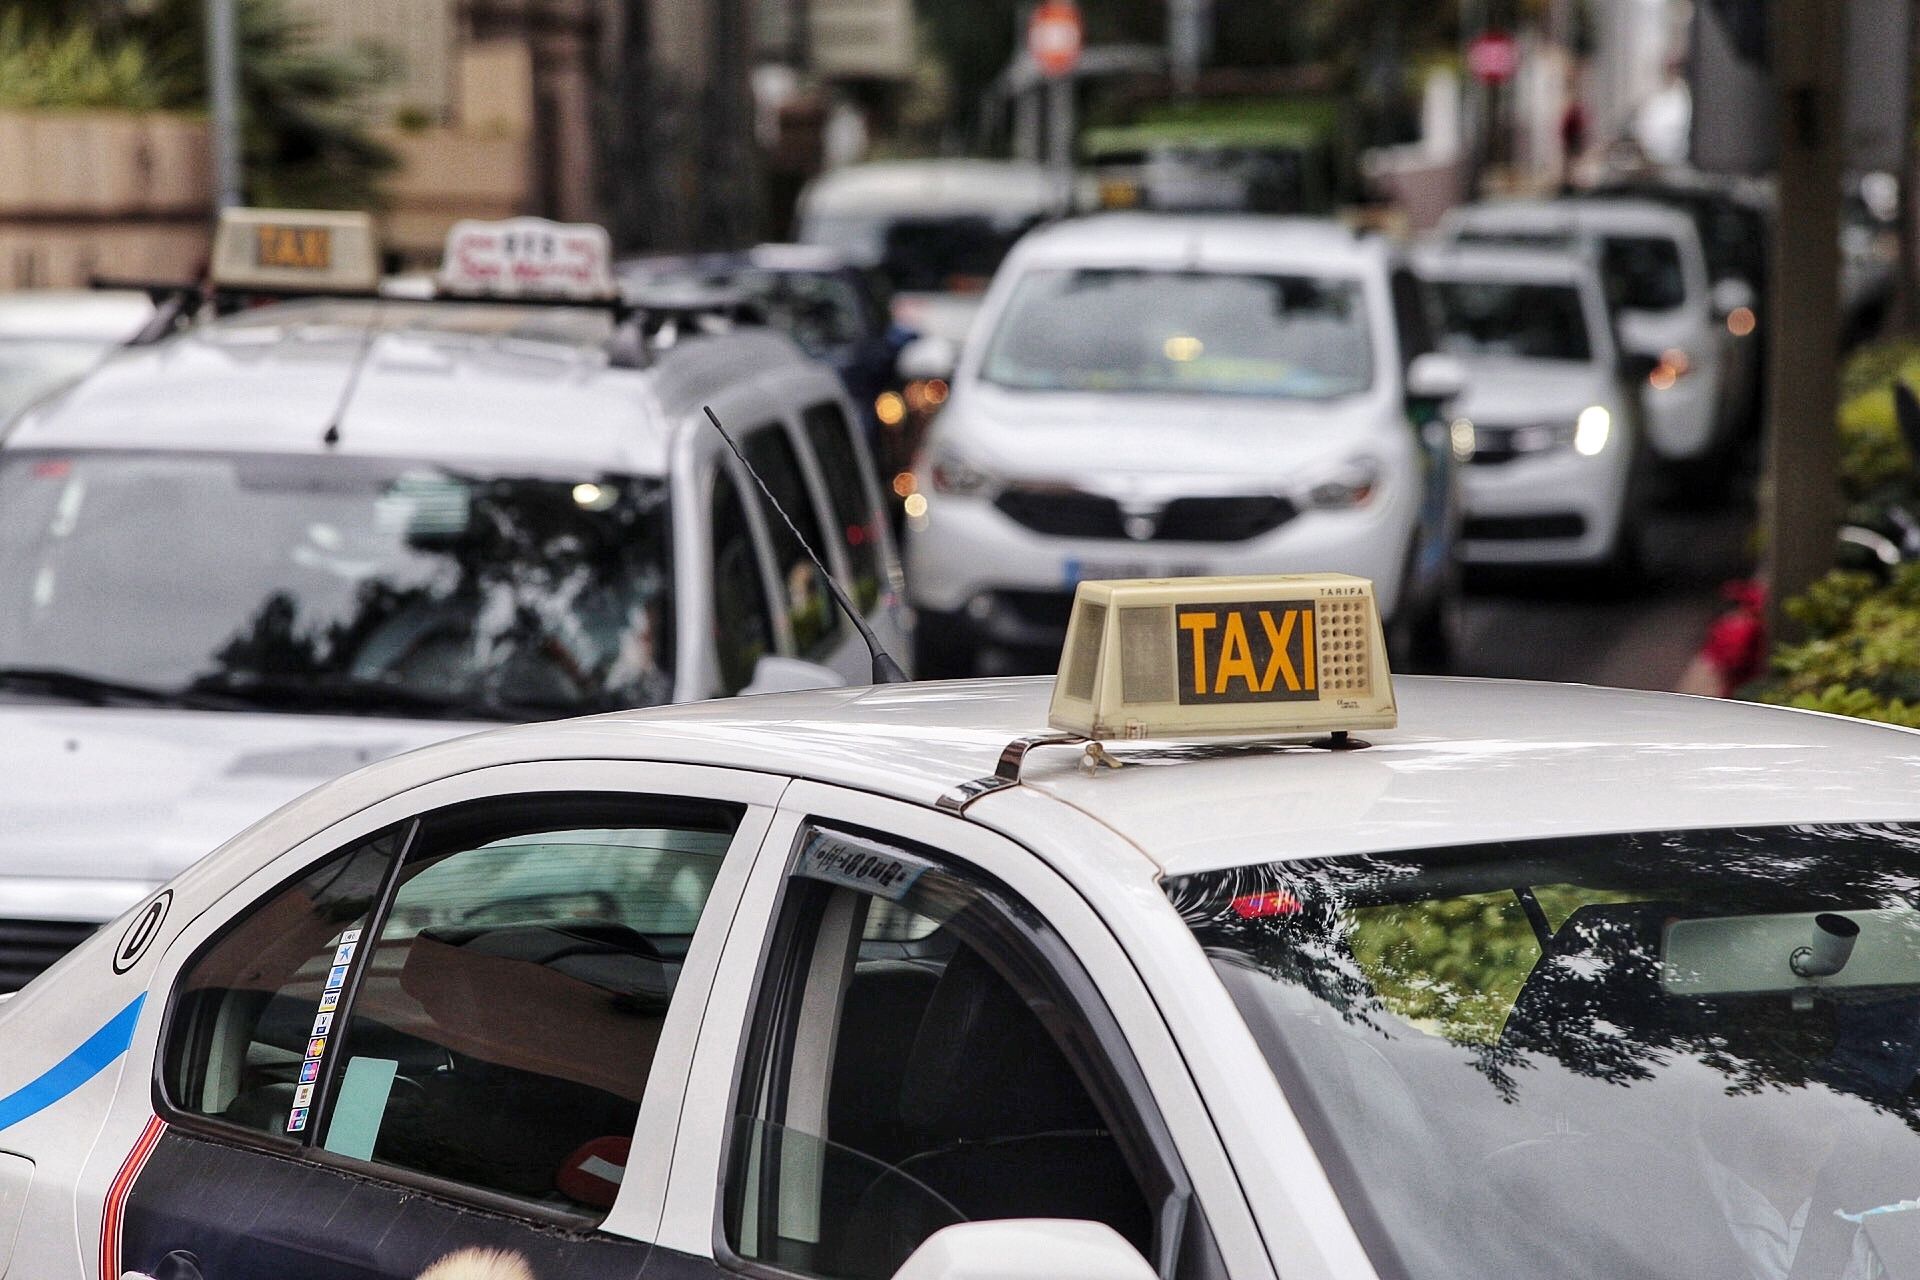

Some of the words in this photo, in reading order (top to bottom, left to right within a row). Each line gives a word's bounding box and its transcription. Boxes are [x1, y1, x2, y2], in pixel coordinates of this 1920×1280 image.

[260, 224, 329, 266] TAXI
[1320, 587, 1364, 596] TARIFA
[1179, 610, 1315, 694] TAXI
[121, 902, 162, 959] D
[324, 995, 337, 1005] VISA
